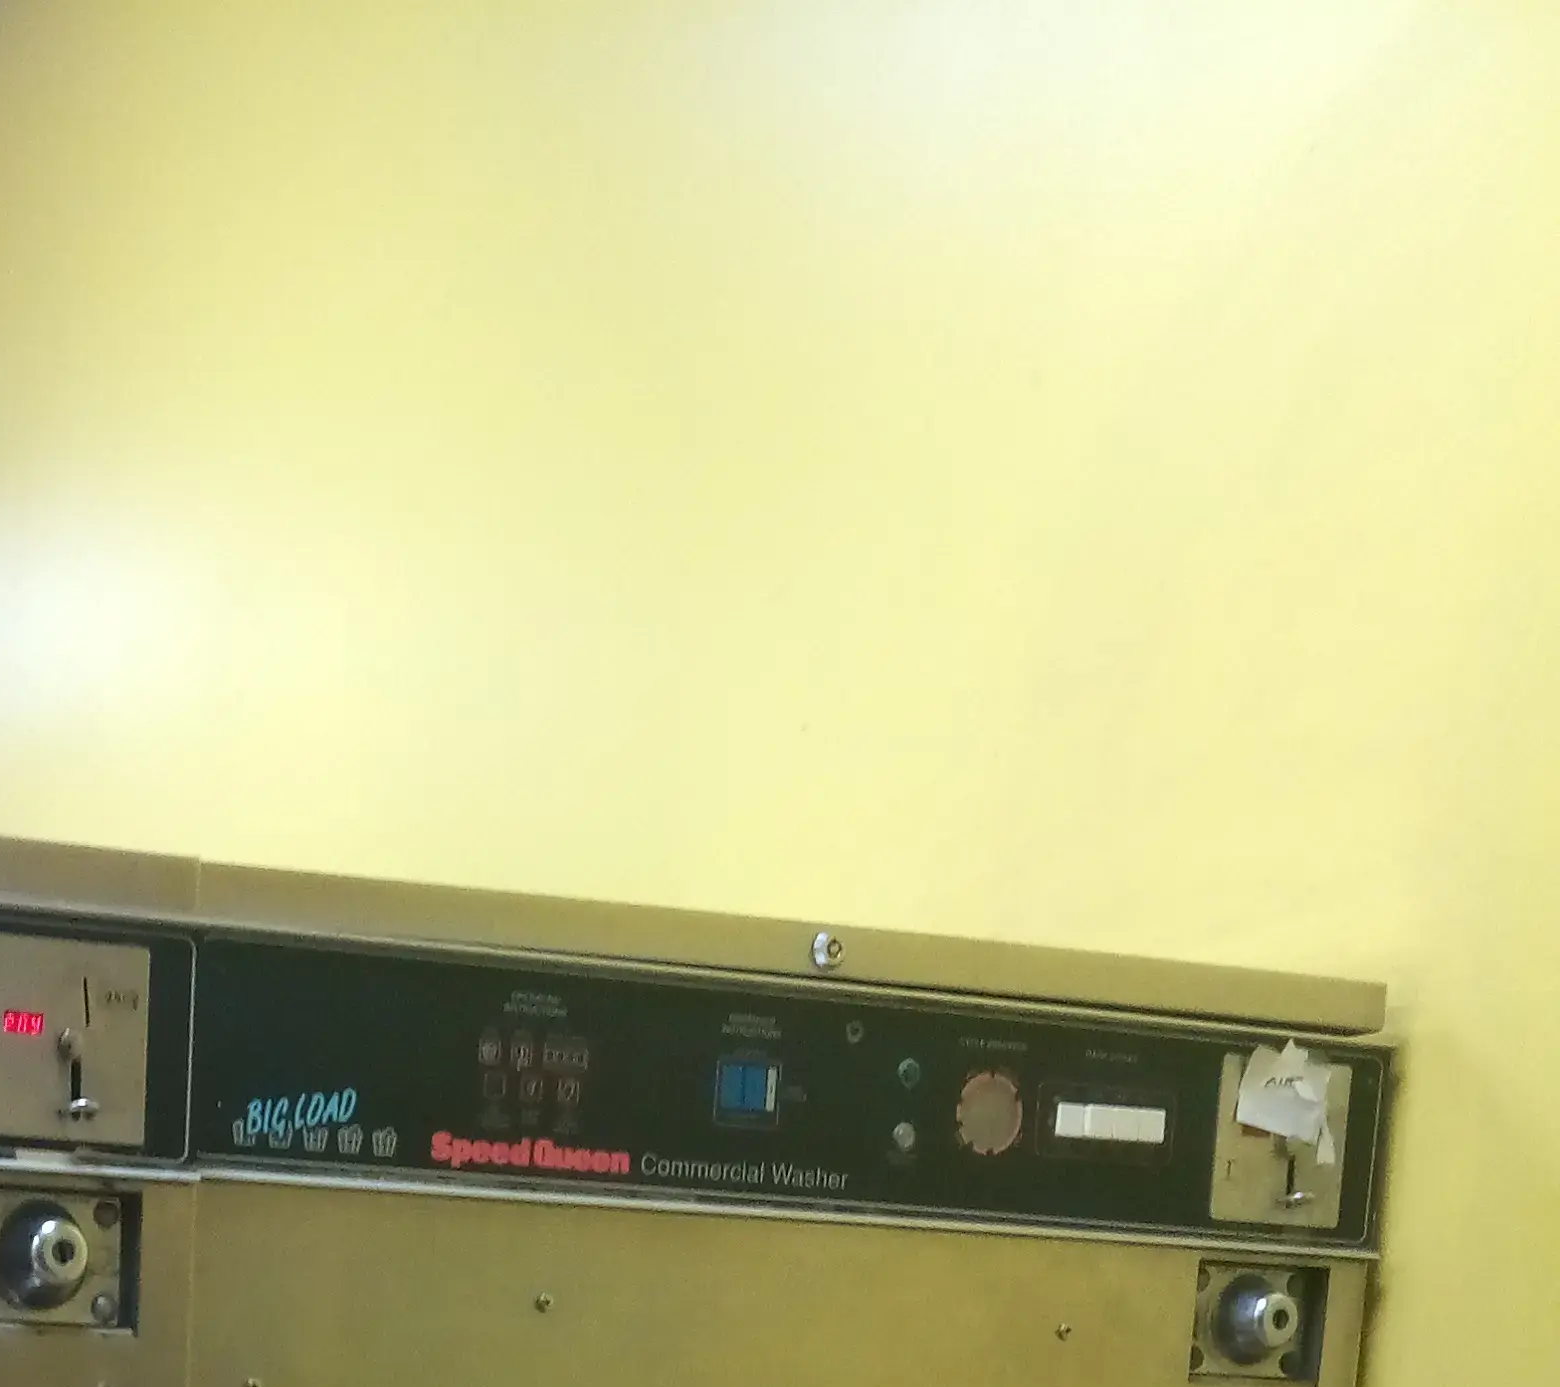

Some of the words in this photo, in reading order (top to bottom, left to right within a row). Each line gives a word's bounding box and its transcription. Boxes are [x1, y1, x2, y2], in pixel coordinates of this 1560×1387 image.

[246, 1096, 289, 1138] BIG
[294, 1087, 357, 1129] LOAD
[431, 1130, 531, 1168] Speed
[534, 1138, 630, 1174] Queen
[641, 1152, 765, 1184] Commercial
[772, 1161, 848, 1190] Washer
